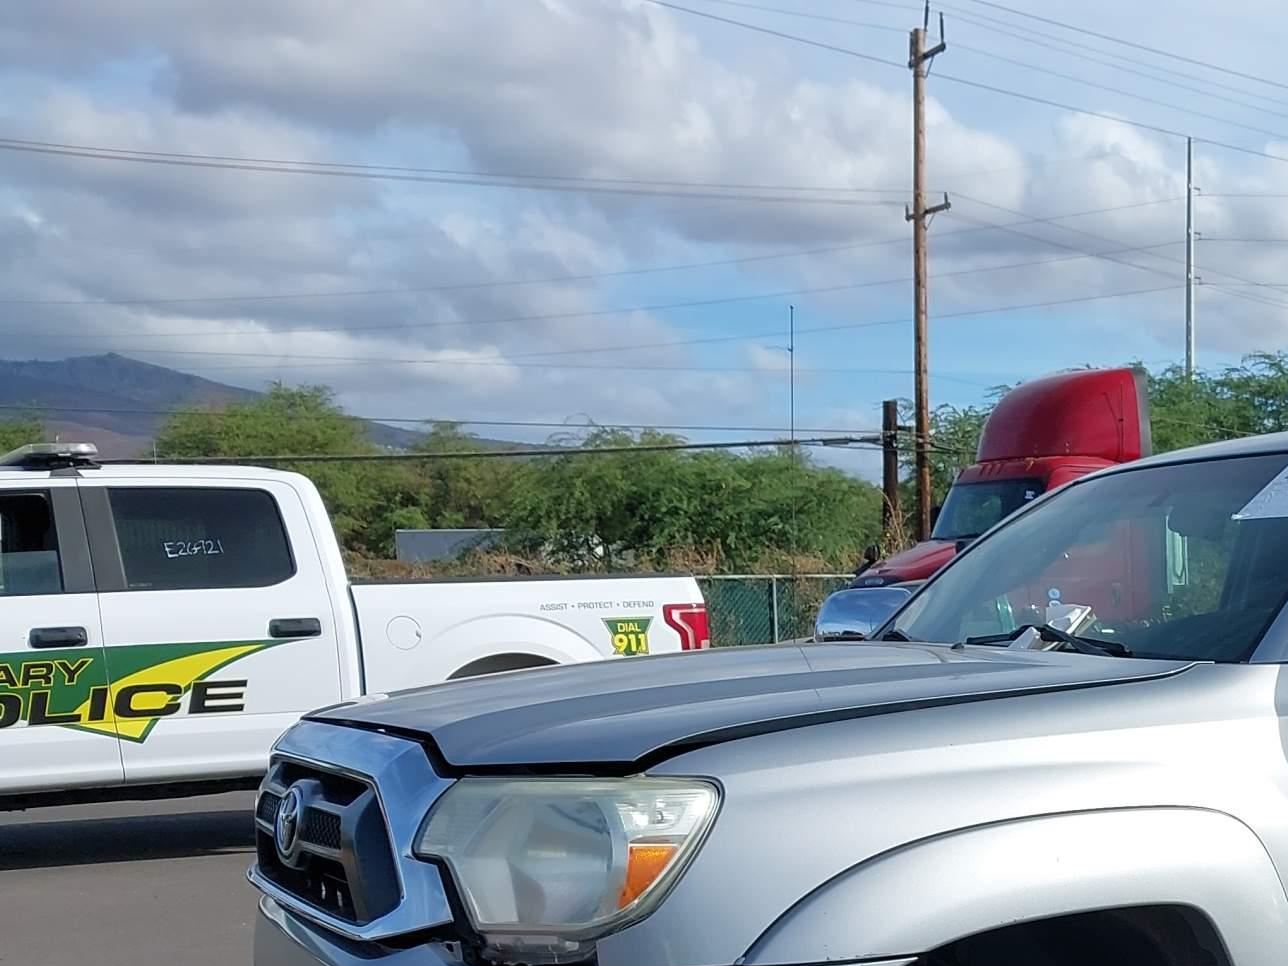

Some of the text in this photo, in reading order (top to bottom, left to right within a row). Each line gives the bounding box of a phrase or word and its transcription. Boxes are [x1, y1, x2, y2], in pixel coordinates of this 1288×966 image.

[540, 600, 654, 611] ASSIST PROTECT DEFEND
[617, 622, 641, 633] DIAL
[613, 633, 646, 652] 911
